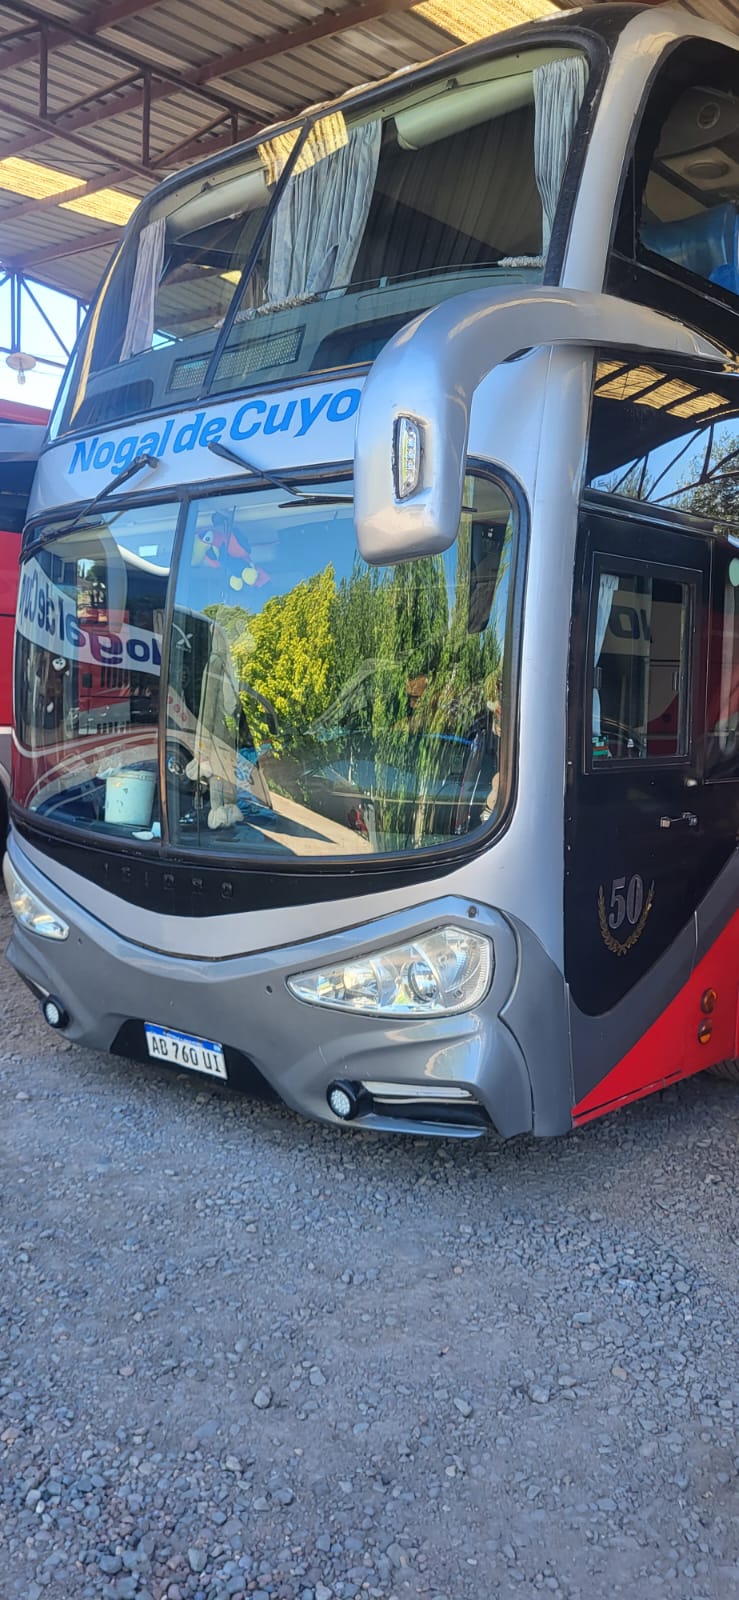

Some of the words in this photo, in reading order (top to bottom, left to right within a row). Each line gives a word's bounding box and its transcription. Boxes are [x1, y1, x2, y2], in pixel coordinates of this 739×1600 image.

[68, 419, 176, 475] Nogal
[173, 411, 228, 454] de
[229, 388, 362, 441] Cuyo
[608, 873, 643, 929] 50
[151, 1035, 169, 1057] AB
[172, 1041, 199, 1067] 760
[202, 1050, 222, 1073] UI
